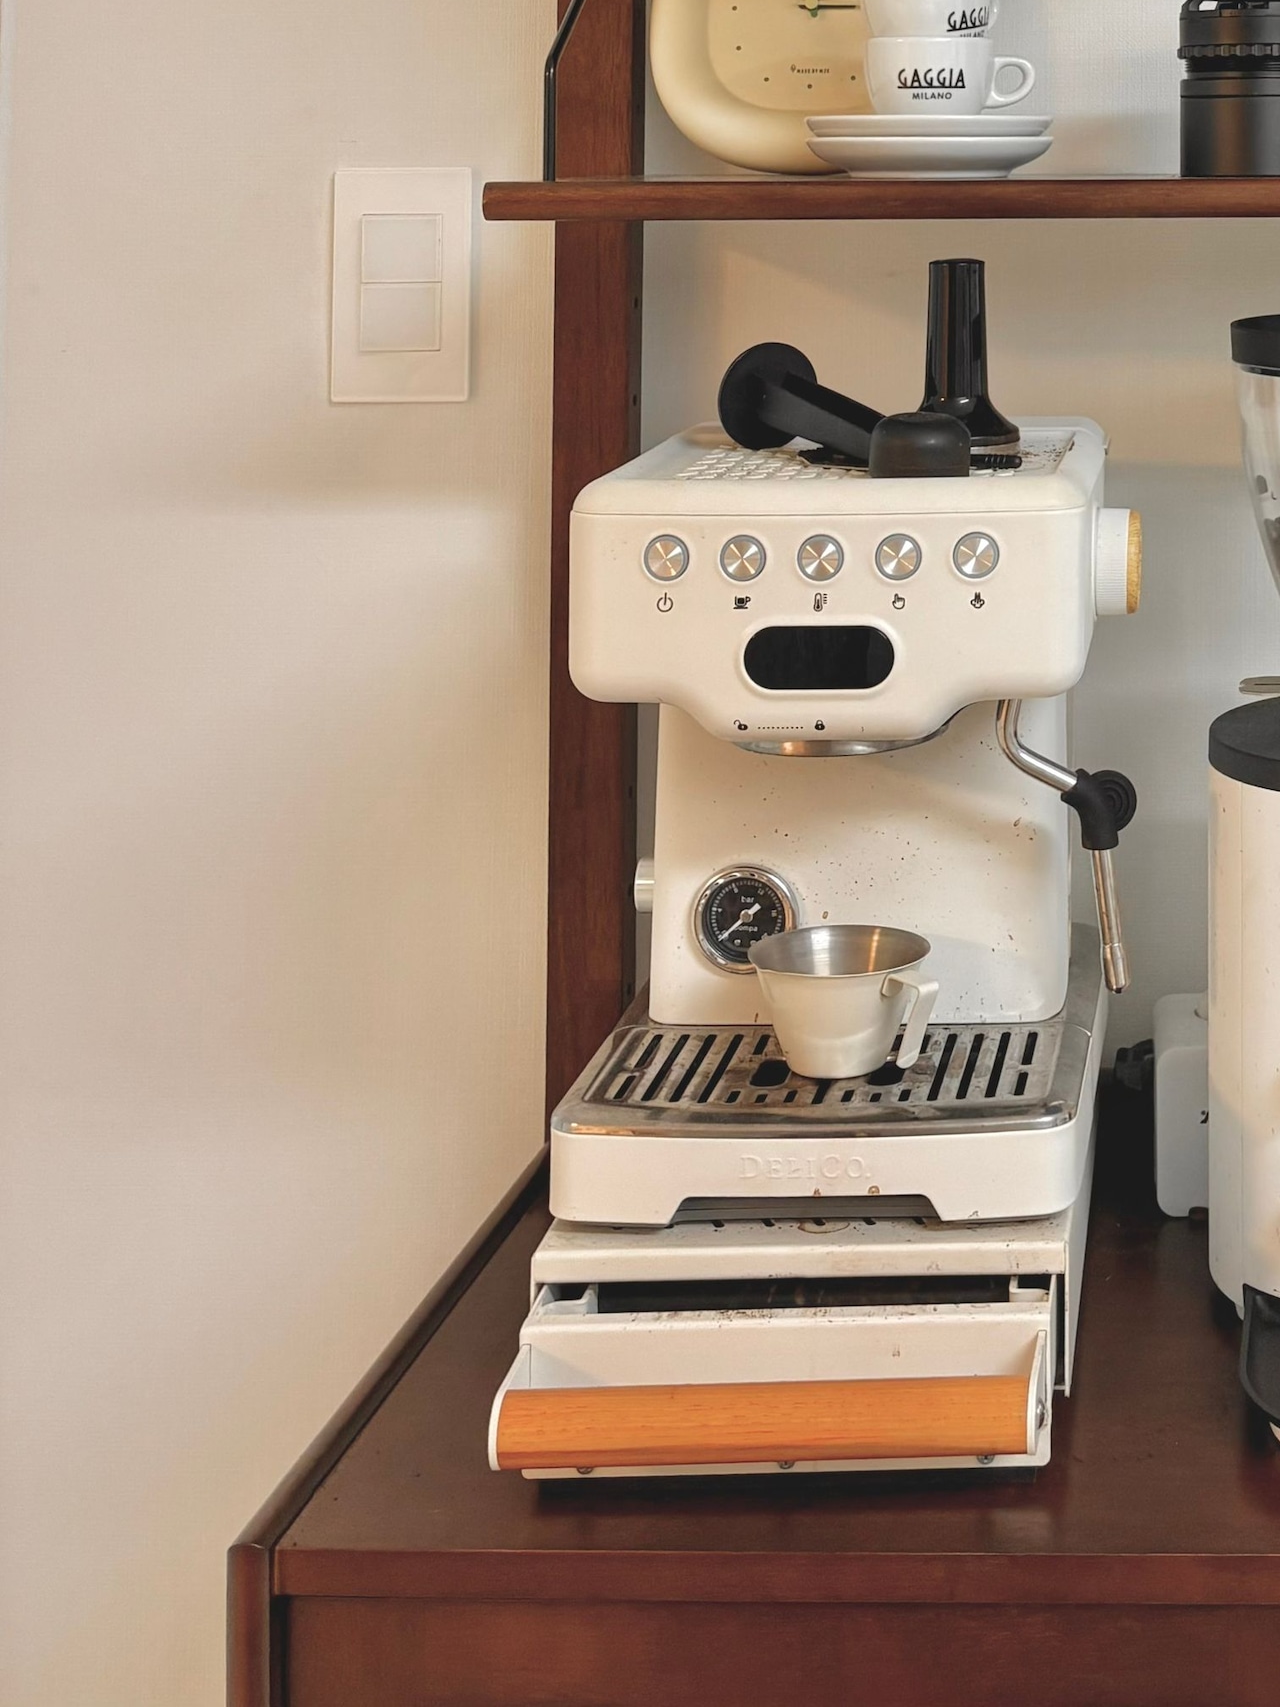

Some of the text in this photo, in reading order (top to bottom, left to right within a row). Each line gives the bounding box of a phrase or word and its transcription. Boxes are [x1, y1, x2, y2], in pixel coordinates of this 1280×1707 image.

[897, 68, 966, 89] GAGGIA
[912, 92, 952, 100] MILANO
[741, 895, 755, 903] bar
